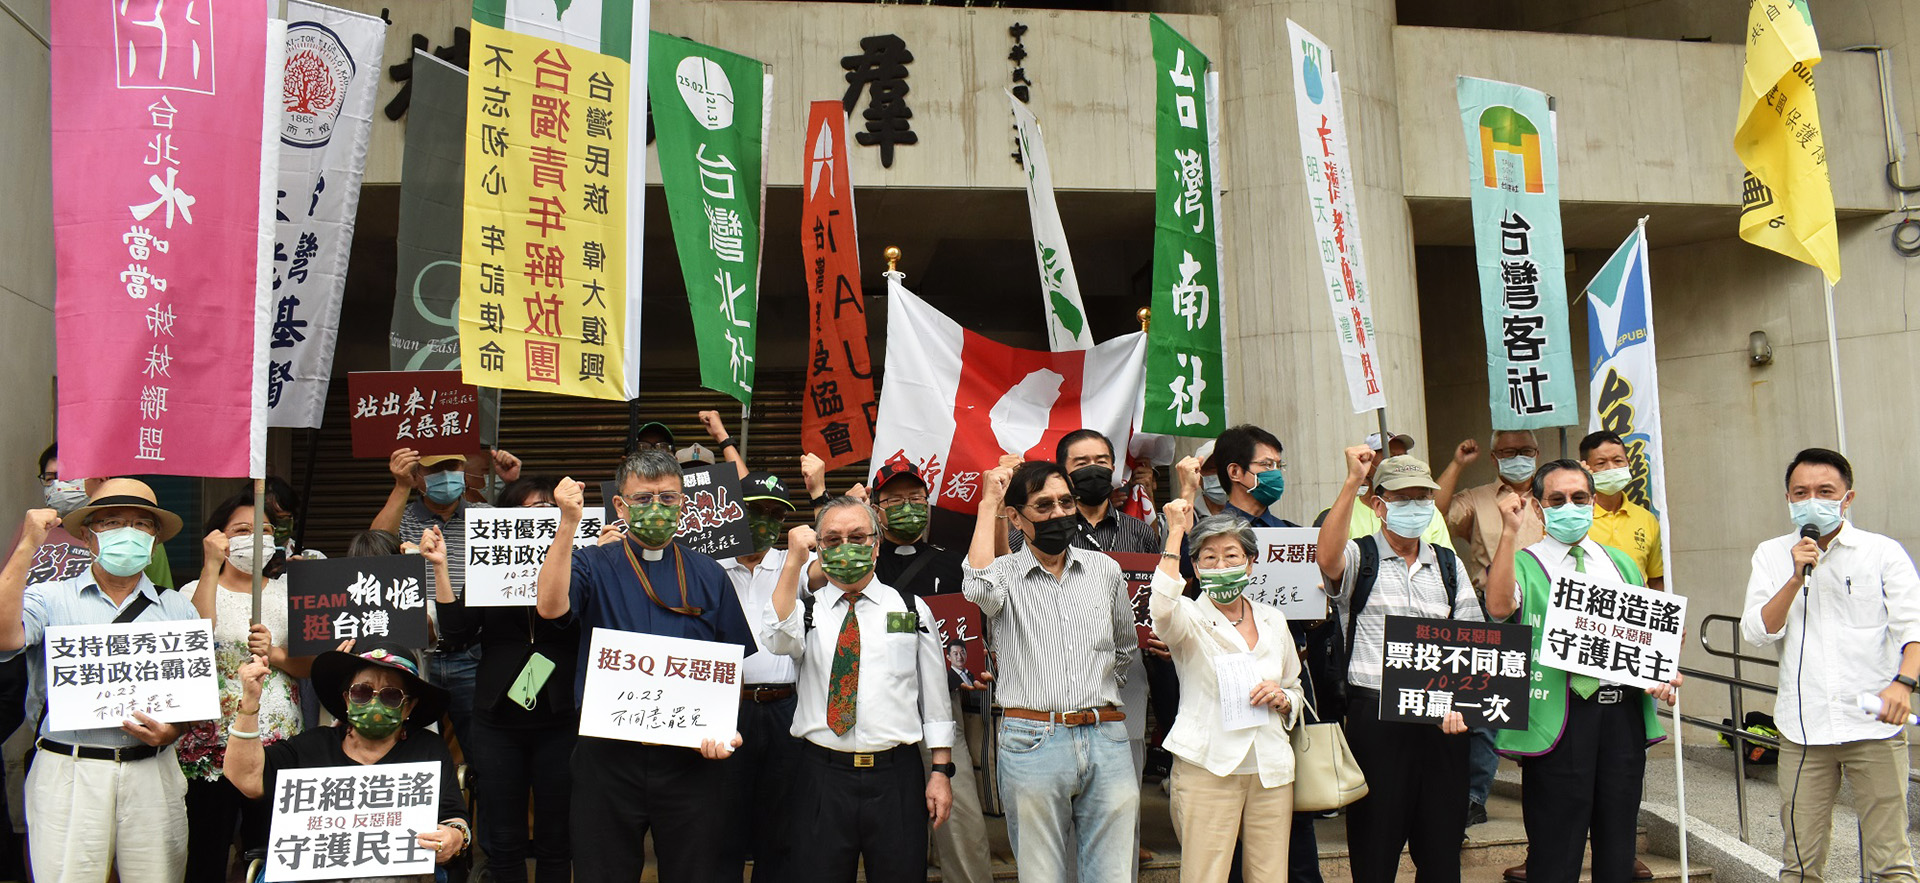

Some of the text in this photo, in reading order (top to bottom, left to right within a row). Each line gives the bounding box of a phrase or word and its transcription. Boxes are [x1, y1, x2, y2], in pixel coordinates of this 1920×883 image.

[678, 75, 704, 94] 25.02
[291, 114, 314, 124] 1865
[1167, 47, 1209, 428] 台灣南社
[696, 143, 752, 392] 台灣北社
[1500, 209, 1554, 415] 台灣客社
[470, 519, 602, 539] 支持優秀委
[504, 568, 538, 580] 10.23
[289, 594, 348, 609] TEAM
[1553, 577, 1682, 635] 拒絕造謠
[51, 630, 209, 660] 支持優秀立委
[1416, 624, 1501, 645] 挺3Q 反惡罷
[1575, 616, 1653, 646] 挺3Q 反惡罷
[597, 647, 737, 685] 挺3Q 反惡罷
[1385, 641, 1527, 679] 票投不同意
[1547, 628, 1673, 684] 守護民主
[52, 656, 212, 687] 反對政治霸凌
[96, 685, 137, 699] 10.23
[617, 689, 664, 701] 10.23
[1398, 688, 1511, 723] 再贏一次
[279, 772, 434, 814] 拒絕造謠
[307, 811, 402, 831] 挺3Q 反惡罷
[274, 828, 429, 870] 守護民主
